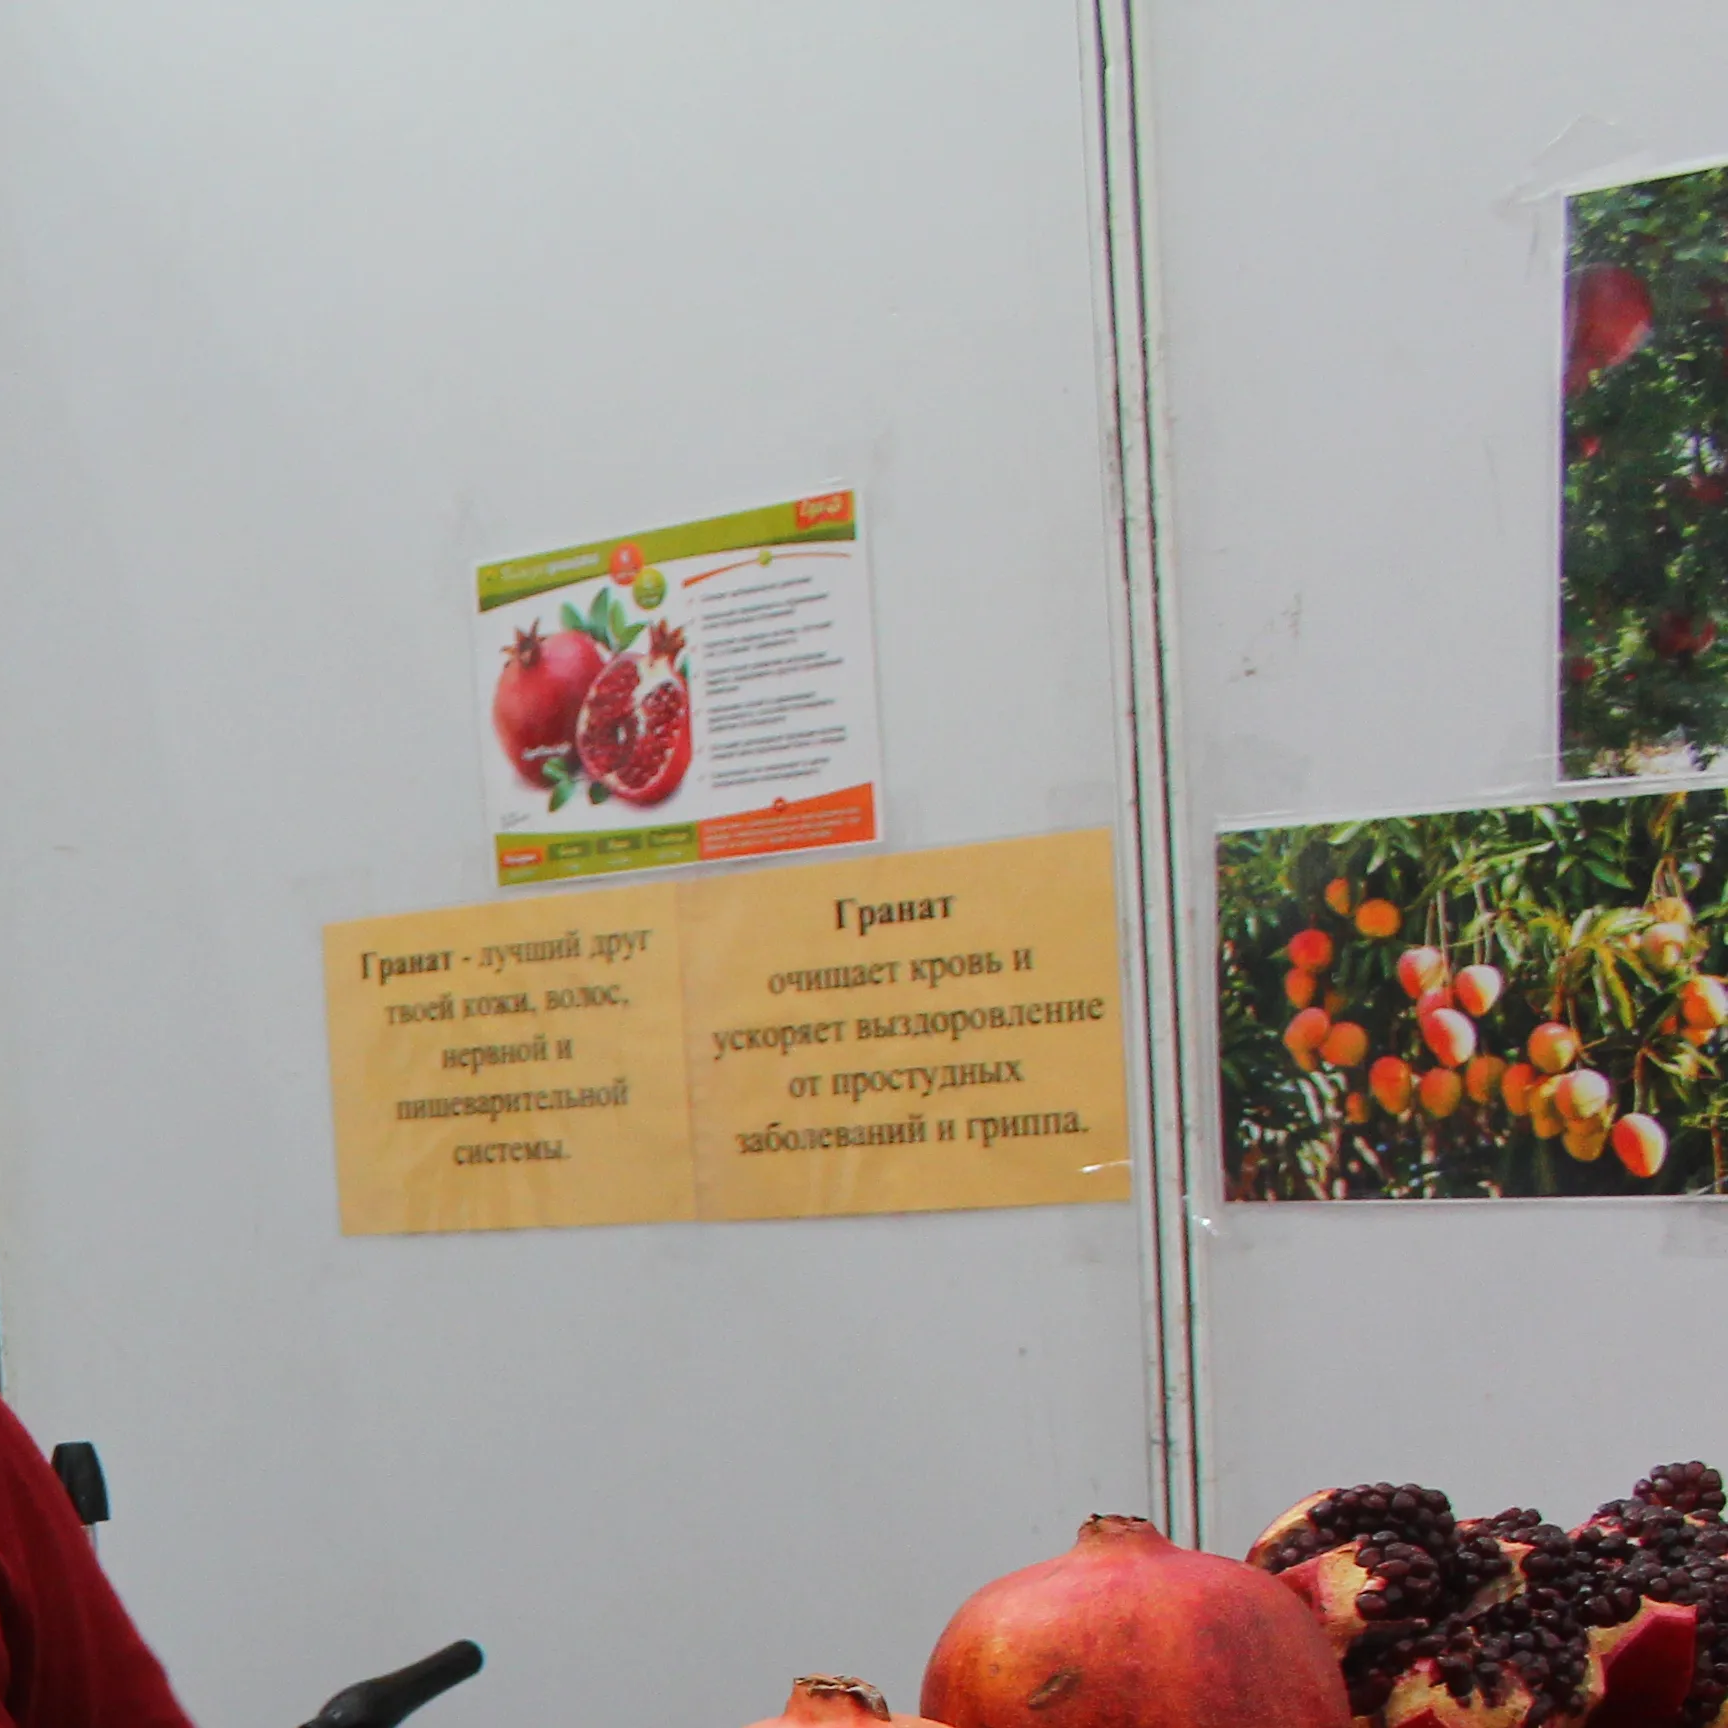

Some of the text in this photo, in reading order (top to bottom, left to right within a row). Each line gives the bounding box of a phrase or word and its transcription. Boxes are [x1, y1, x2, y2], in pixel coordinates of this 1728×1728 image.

[833, 893, 957, 936] Гранат
[360, 949, 455, 986] Гранат
[478, 929, 582, 974] лучший
[588, 928, 653, 964] друг
[766, 947, 1035, 996] очищает кровь и
[384, 991, 455, 1027] твоей
[710, 995, 1106, 1061] ускоряет выздоровление
[442, 1033, 573, 1076] нервной и
[787, 1058, 1026, 1103] от простудных
[452, 1138, 571, 1166] системы.
[734, 1108, 1091, 1155] заболеваний и гриппа.
